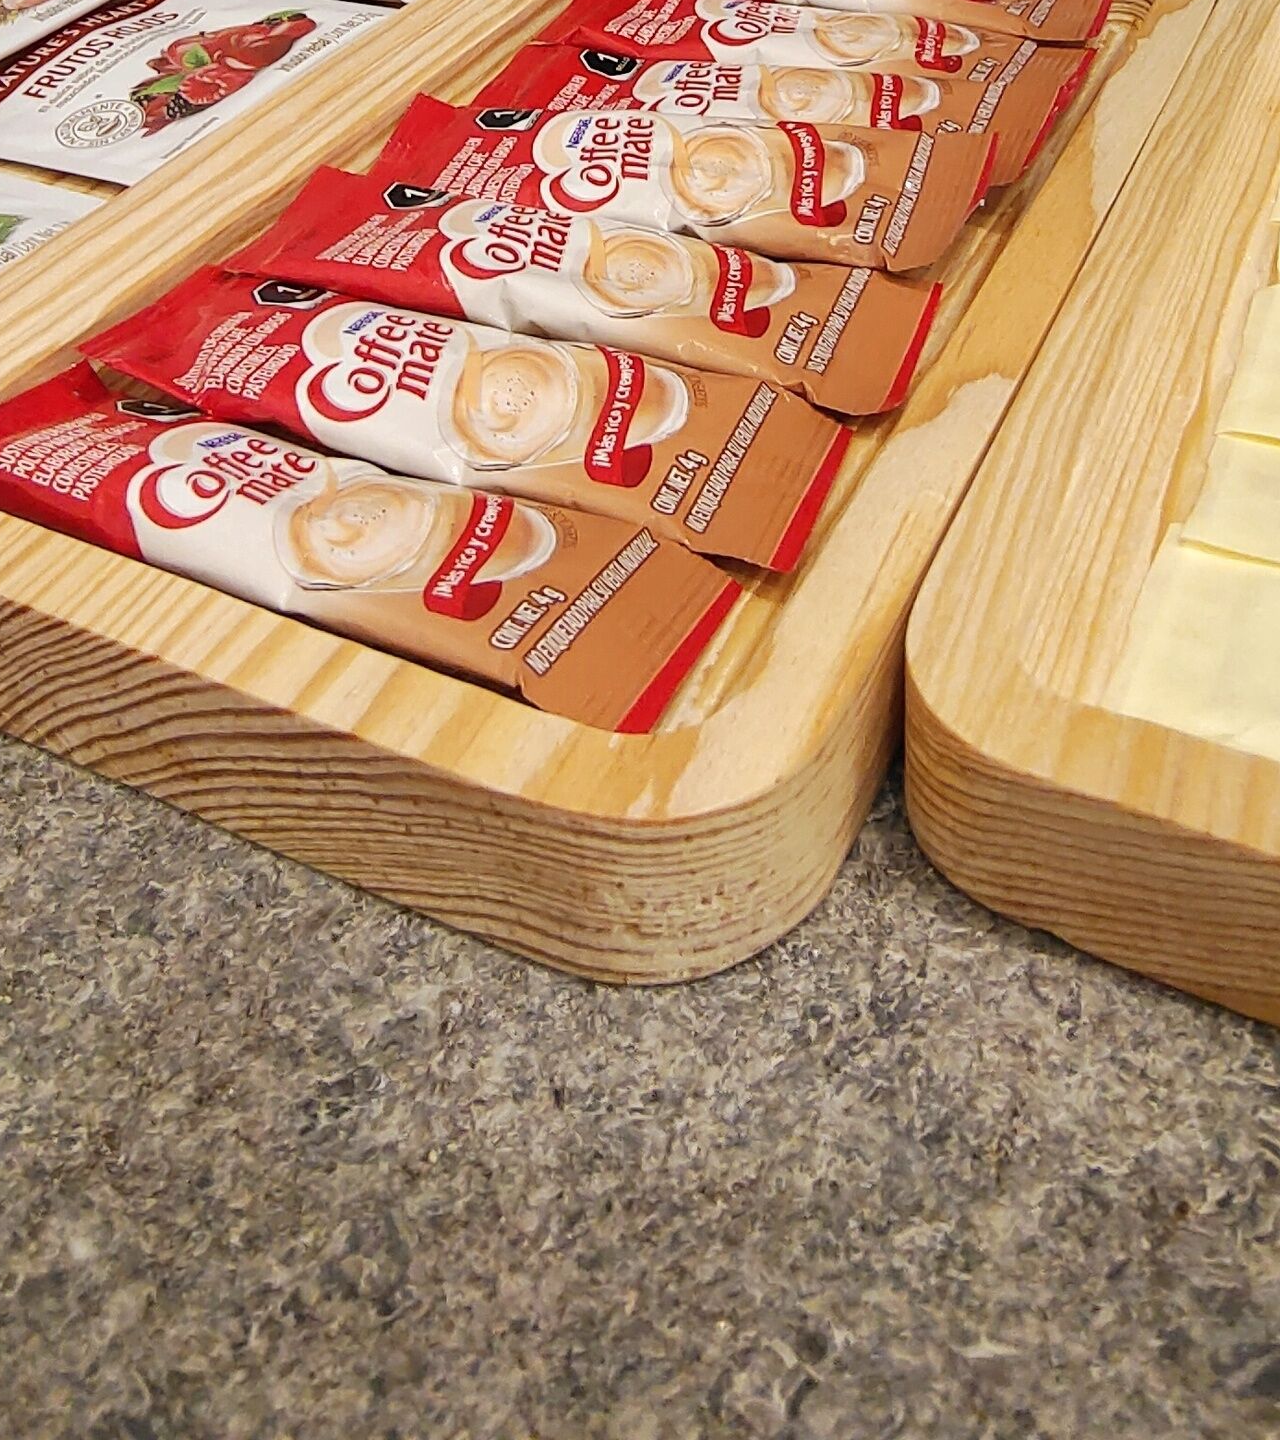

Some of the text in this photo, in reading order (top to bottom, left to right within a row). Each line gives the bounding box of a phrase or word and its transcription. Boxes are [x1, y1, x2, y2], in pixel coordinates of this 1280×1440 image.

[23, 38, 115, 100] FRUTOS
[102, 11, 179, 40] ROJOS
[549, 116, 621, 212] Coffee
[622, 115, 656, 182] mate
[450, 205, 539, 281] Coffee
[528, 210, 574, 273] mate
[307, 312, 418, 422] Coffee
[396, 320, 455, 401] mate
[592, 434, 616, 469] ¡Más
[604, 412, 623, 438] rico
[140, 436, 280, 529] Coffee
[236, 449, 319, 505] mate
[652, 482, 680, 515] CONT.
[670, 463, 695, 492] NET.
[431, 568, 465, 598] ¡Más
[454, 547, 478, 571] rico
[491, 600, 548, 650] CONT. NET.
